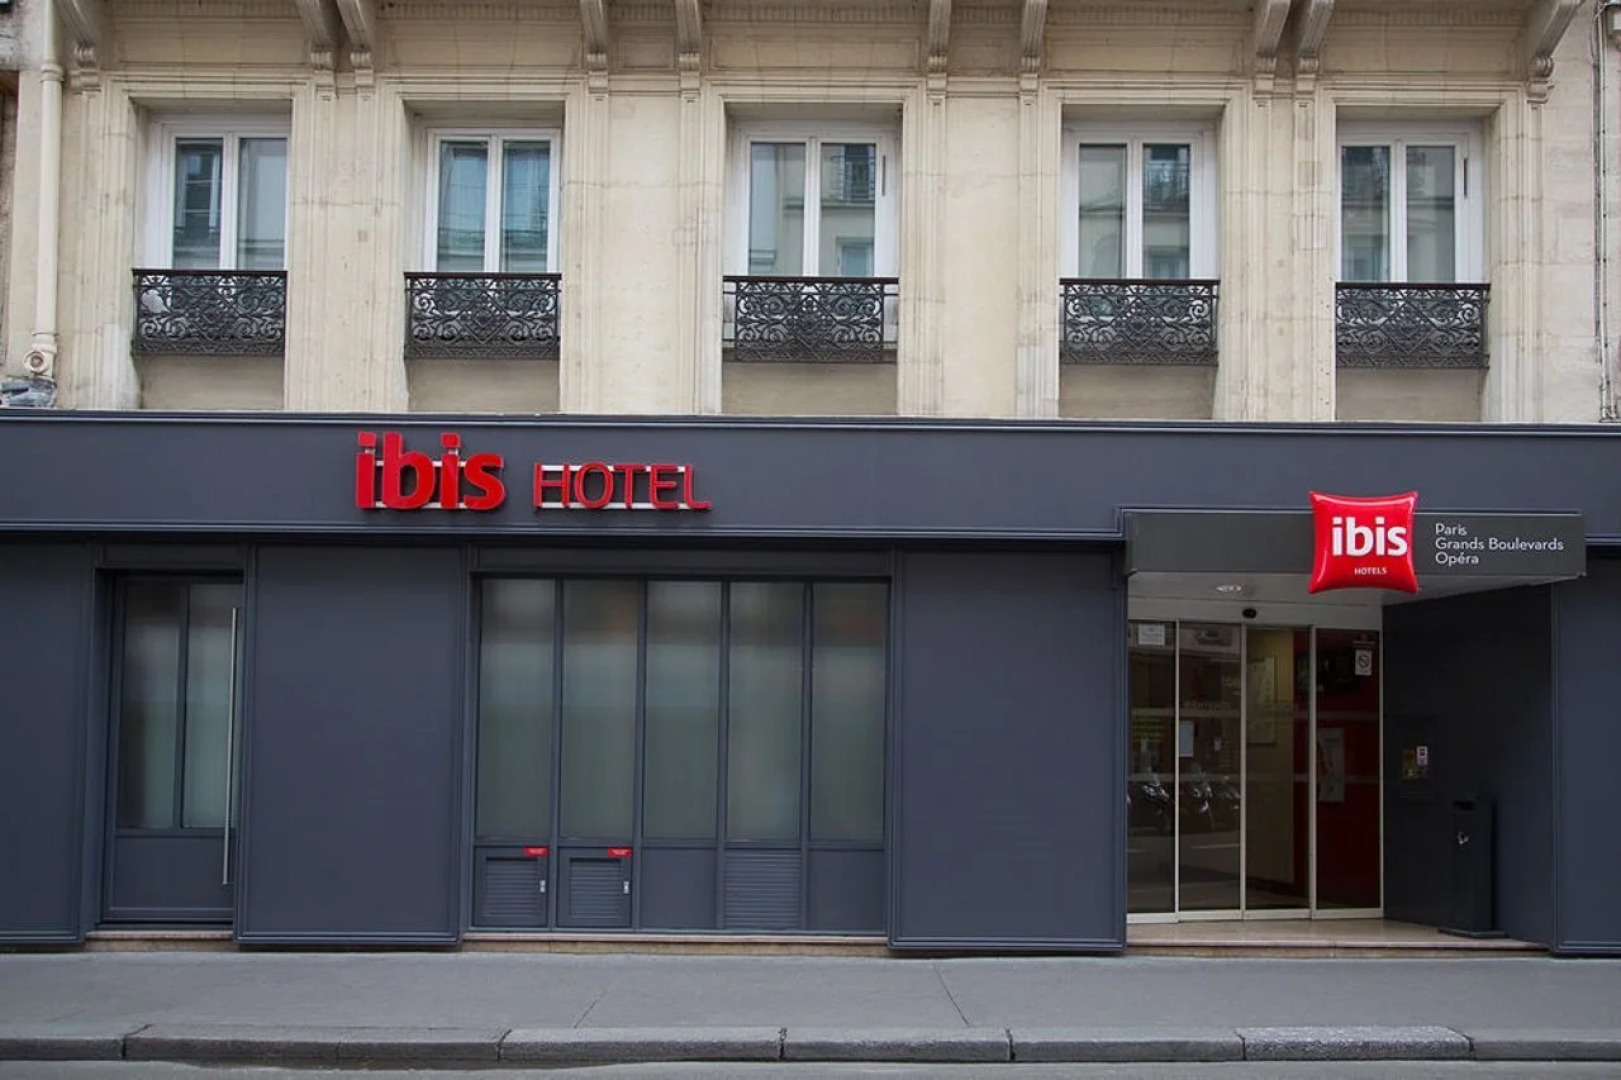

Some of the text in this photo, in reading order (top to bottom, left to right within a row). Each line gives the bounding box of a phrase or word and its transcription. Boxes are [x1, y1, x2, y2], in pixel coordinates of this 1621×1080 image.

[356, 432, 711, 510] ibis HOTEL
[1332, 516, 1408, 557] ibis
[1435, 522, 1468, 536] Paris
[1435, 537, 1564, 550] Grands Boulevards
[1435, 551, 1479, 567] Opéra
[1354, 567, 1388, 575] HOTELS
